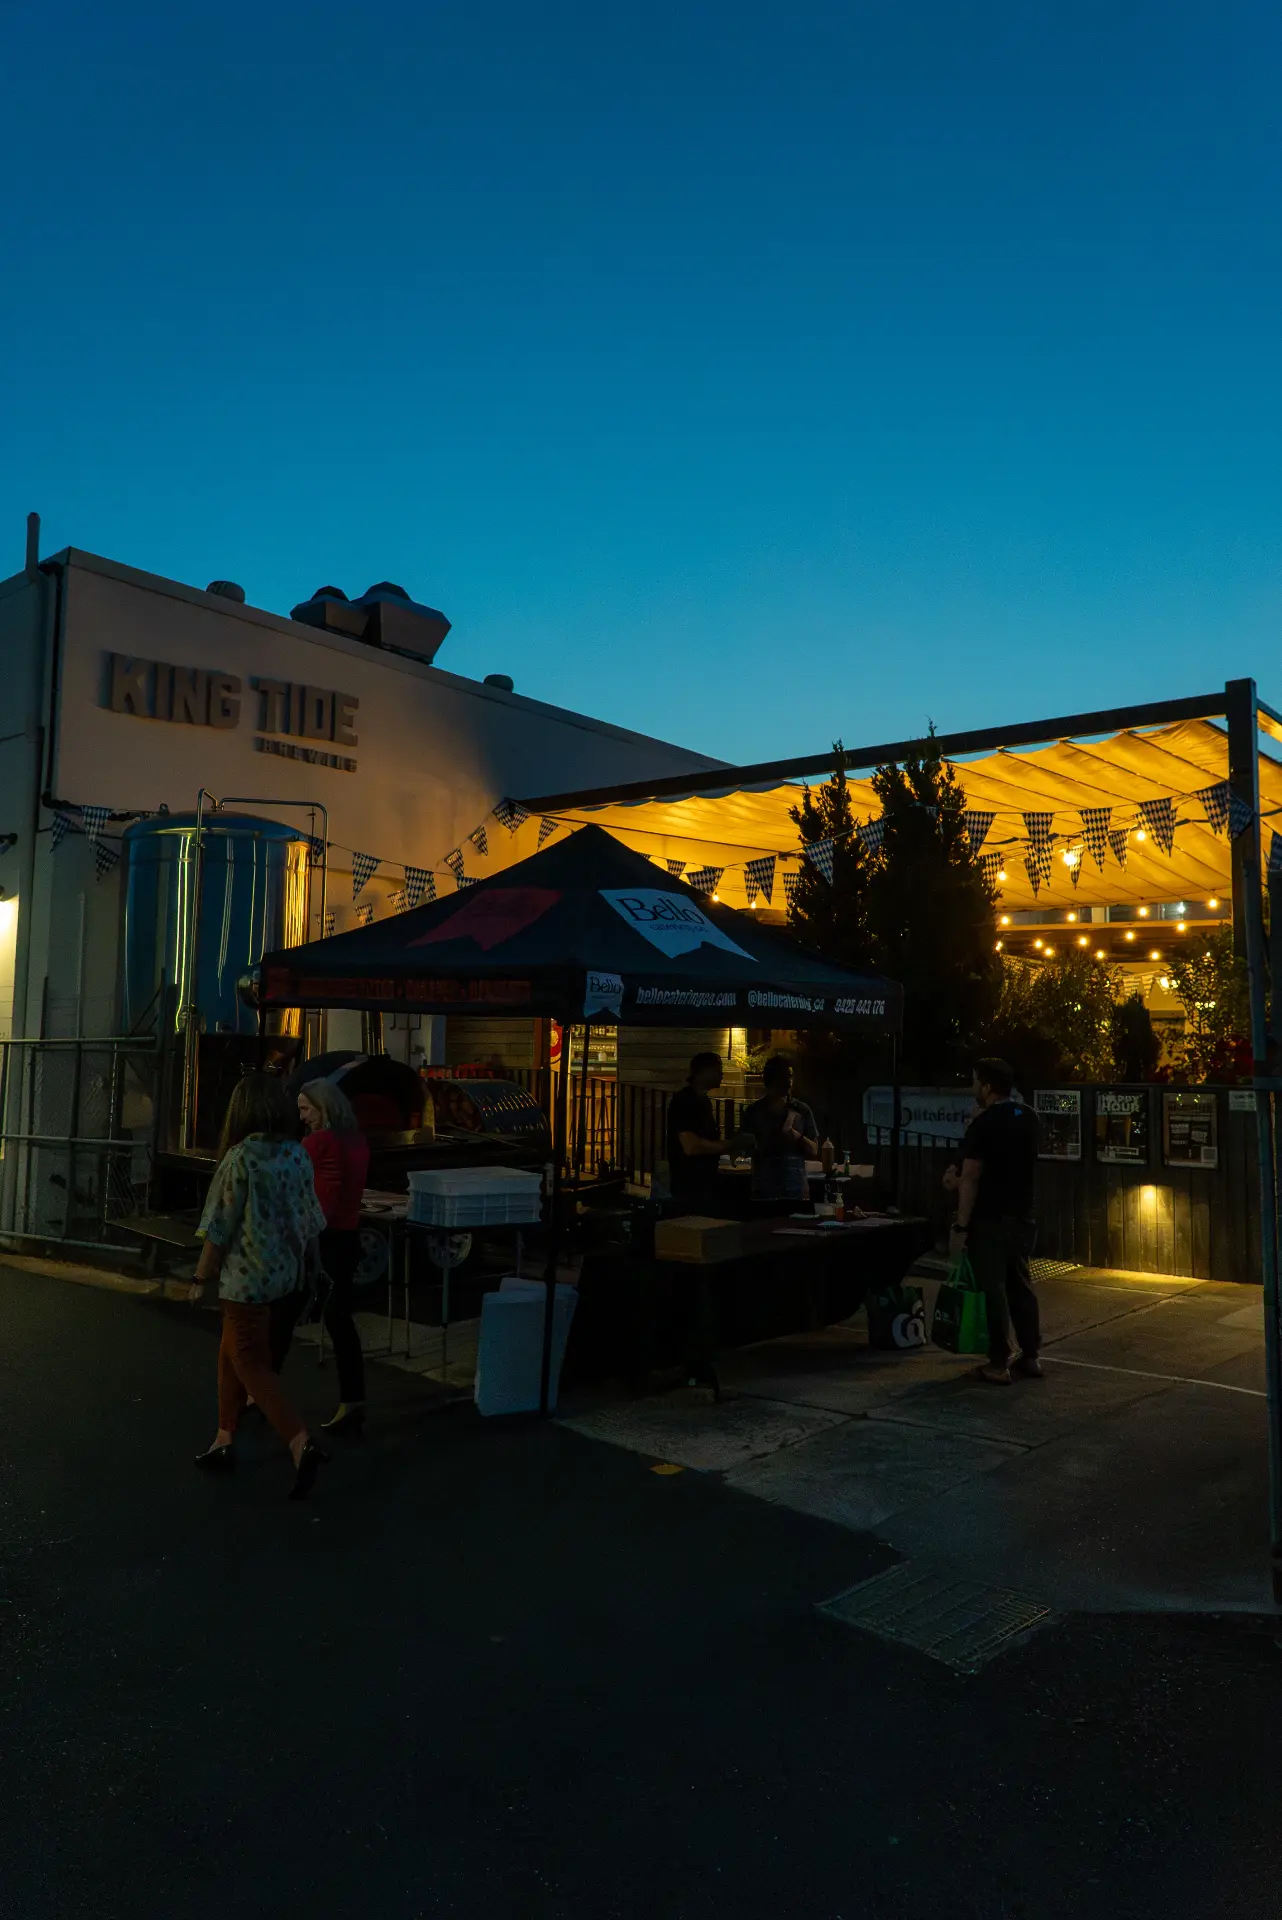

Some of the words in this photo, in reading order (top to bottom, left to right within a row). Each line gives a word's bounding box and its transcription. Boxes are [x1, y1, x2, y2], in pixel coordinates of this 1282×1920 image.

[104, 652, 242, 729] KING
[250, 676, 359, 747] TIDE
[615, 896, 706, 925] Bello
[589, 976, 624, 994] Bello
[635, 986, 738, 1008] bellocateringco.com
[1102, 1101, 1140, 1113] HOUR
